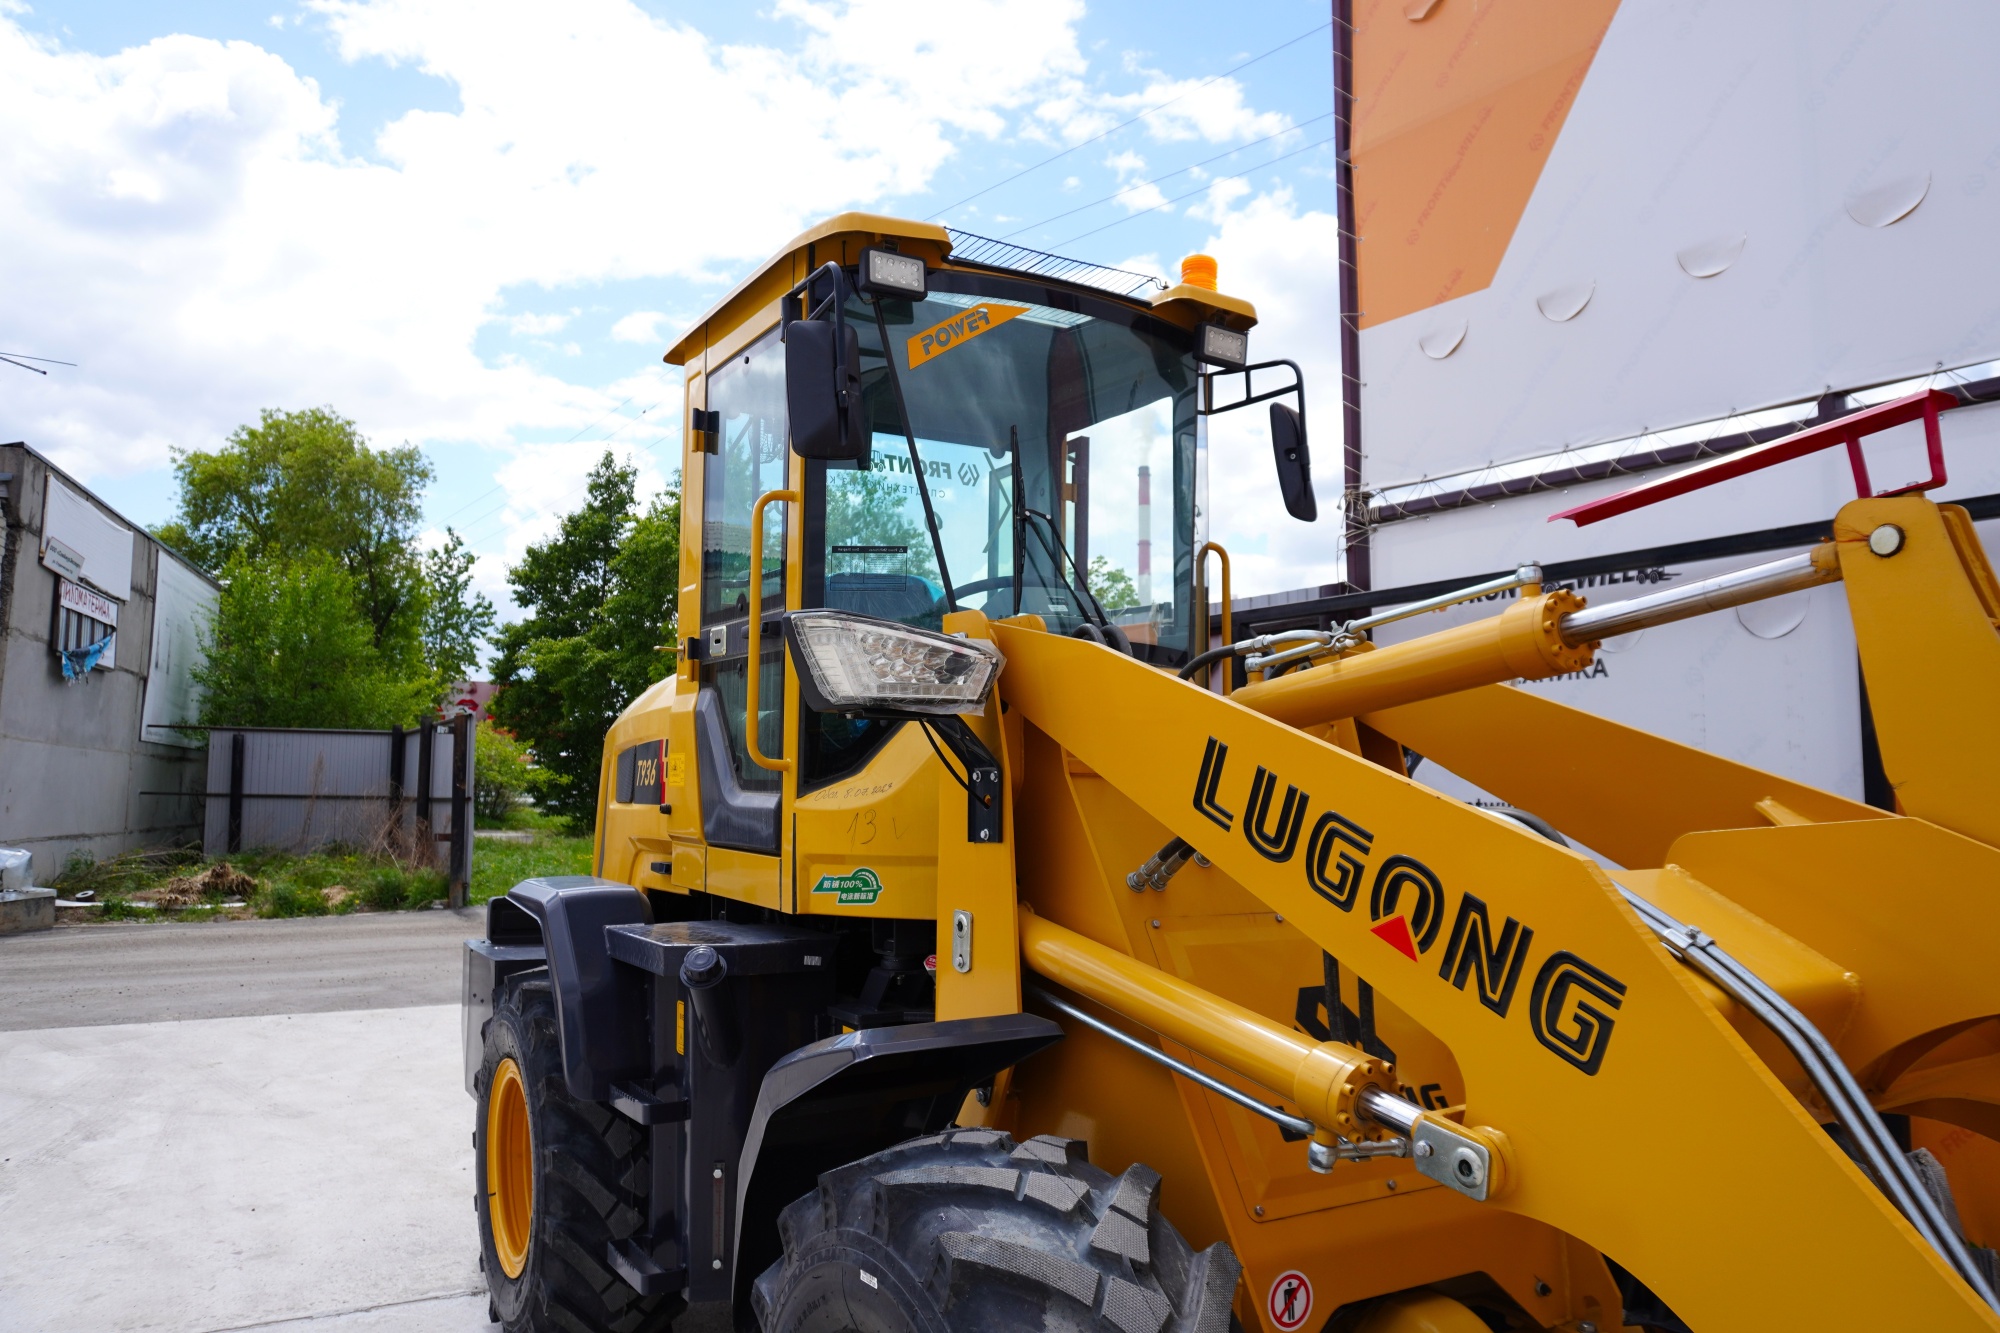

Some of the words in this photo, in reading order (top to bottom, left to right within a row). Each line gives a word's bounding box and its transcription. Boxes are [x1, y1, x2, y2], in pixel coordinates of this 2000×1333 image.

[920, 308, 990, 356] POWER
[637, 758, 657, 787] T936
[1193, 735, 1628, 1077] LUGONG
